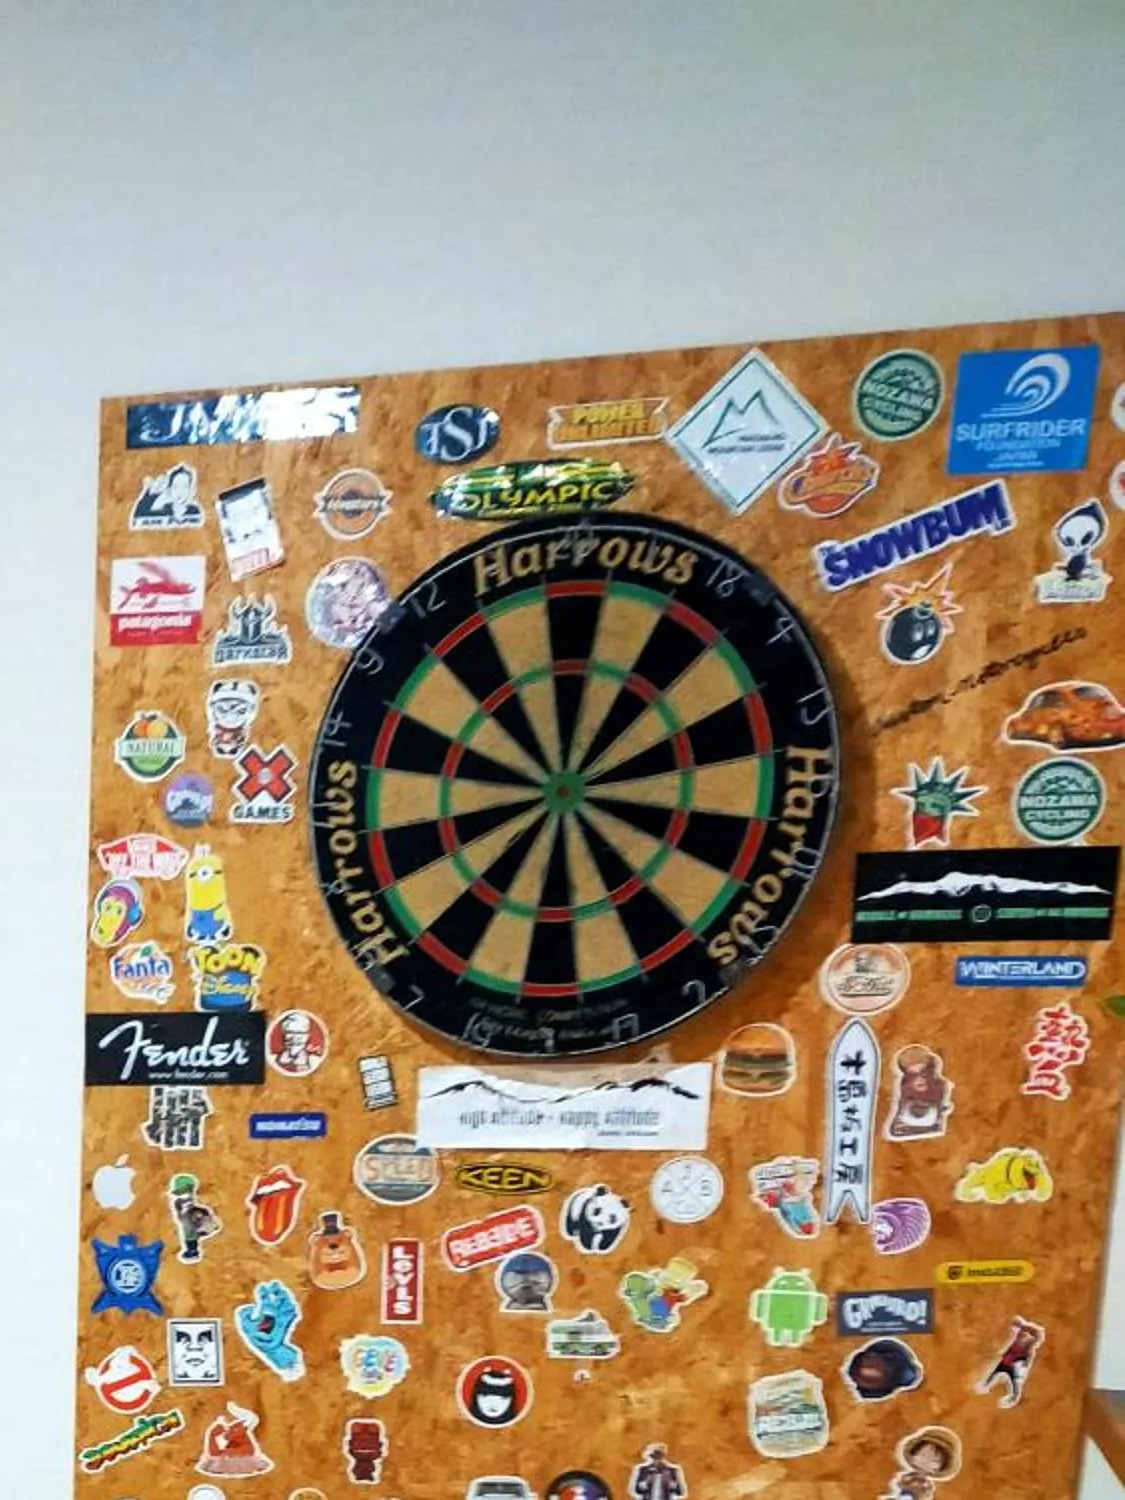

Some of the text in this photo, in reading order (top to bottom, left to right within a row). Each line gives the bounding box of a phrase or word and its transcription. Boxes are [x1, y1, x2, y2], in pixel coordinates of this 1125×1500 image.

[955, 419, 1086, 442] SURFRIDER
[474, 536, 699, 597] Harrows
[233, 805, 293, 820] GAMES
[325, 759, 411, 966] Harrows
[707, 746, 833, 966] Harrows
[113, 956, 171, 979] Fanta
[194, 947, 261, 975] TOON
[959, 960, 1087, 981] WINTERLAND
[98, 1015, 252, 1081] Fender
[458, 1167, 551, 1187] KEEN
